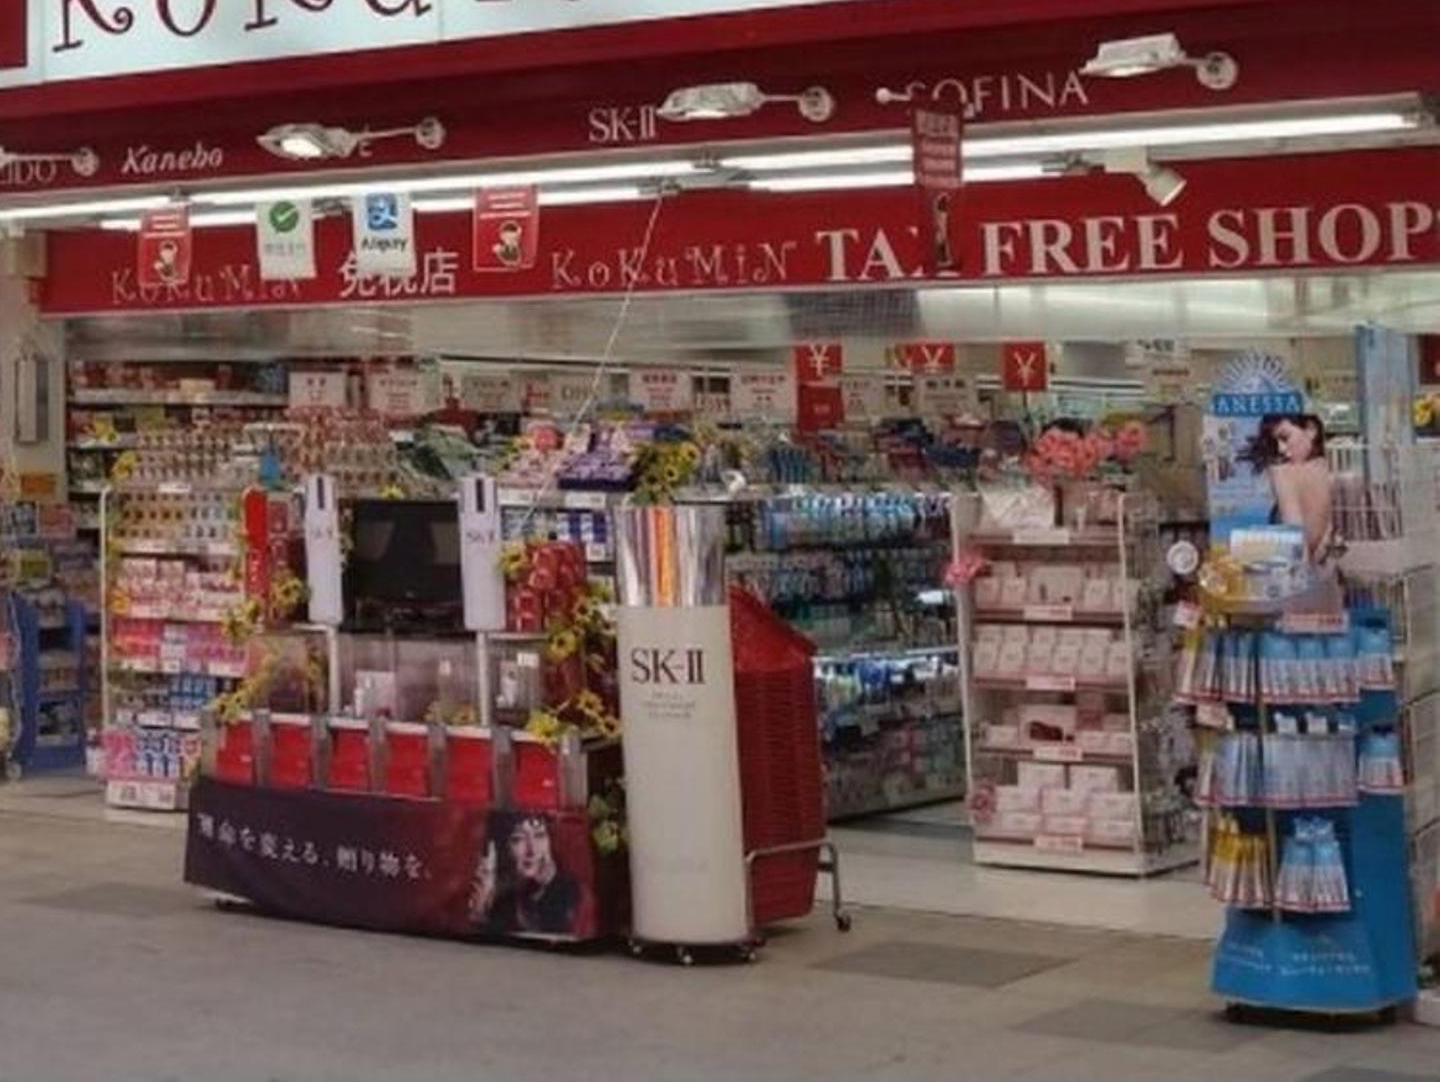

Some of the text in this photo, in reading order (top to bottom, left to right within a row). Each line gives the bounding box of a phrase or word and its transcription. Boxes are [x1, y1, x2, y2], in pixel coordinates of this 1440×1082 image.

[120, 140, 224, 175] Kanebo
[816, 200, 1434, 282] TA FREE SHOP
[1217, 394, 1301, 414] ANESSA
[631, 646, 705, 686] SK-II
